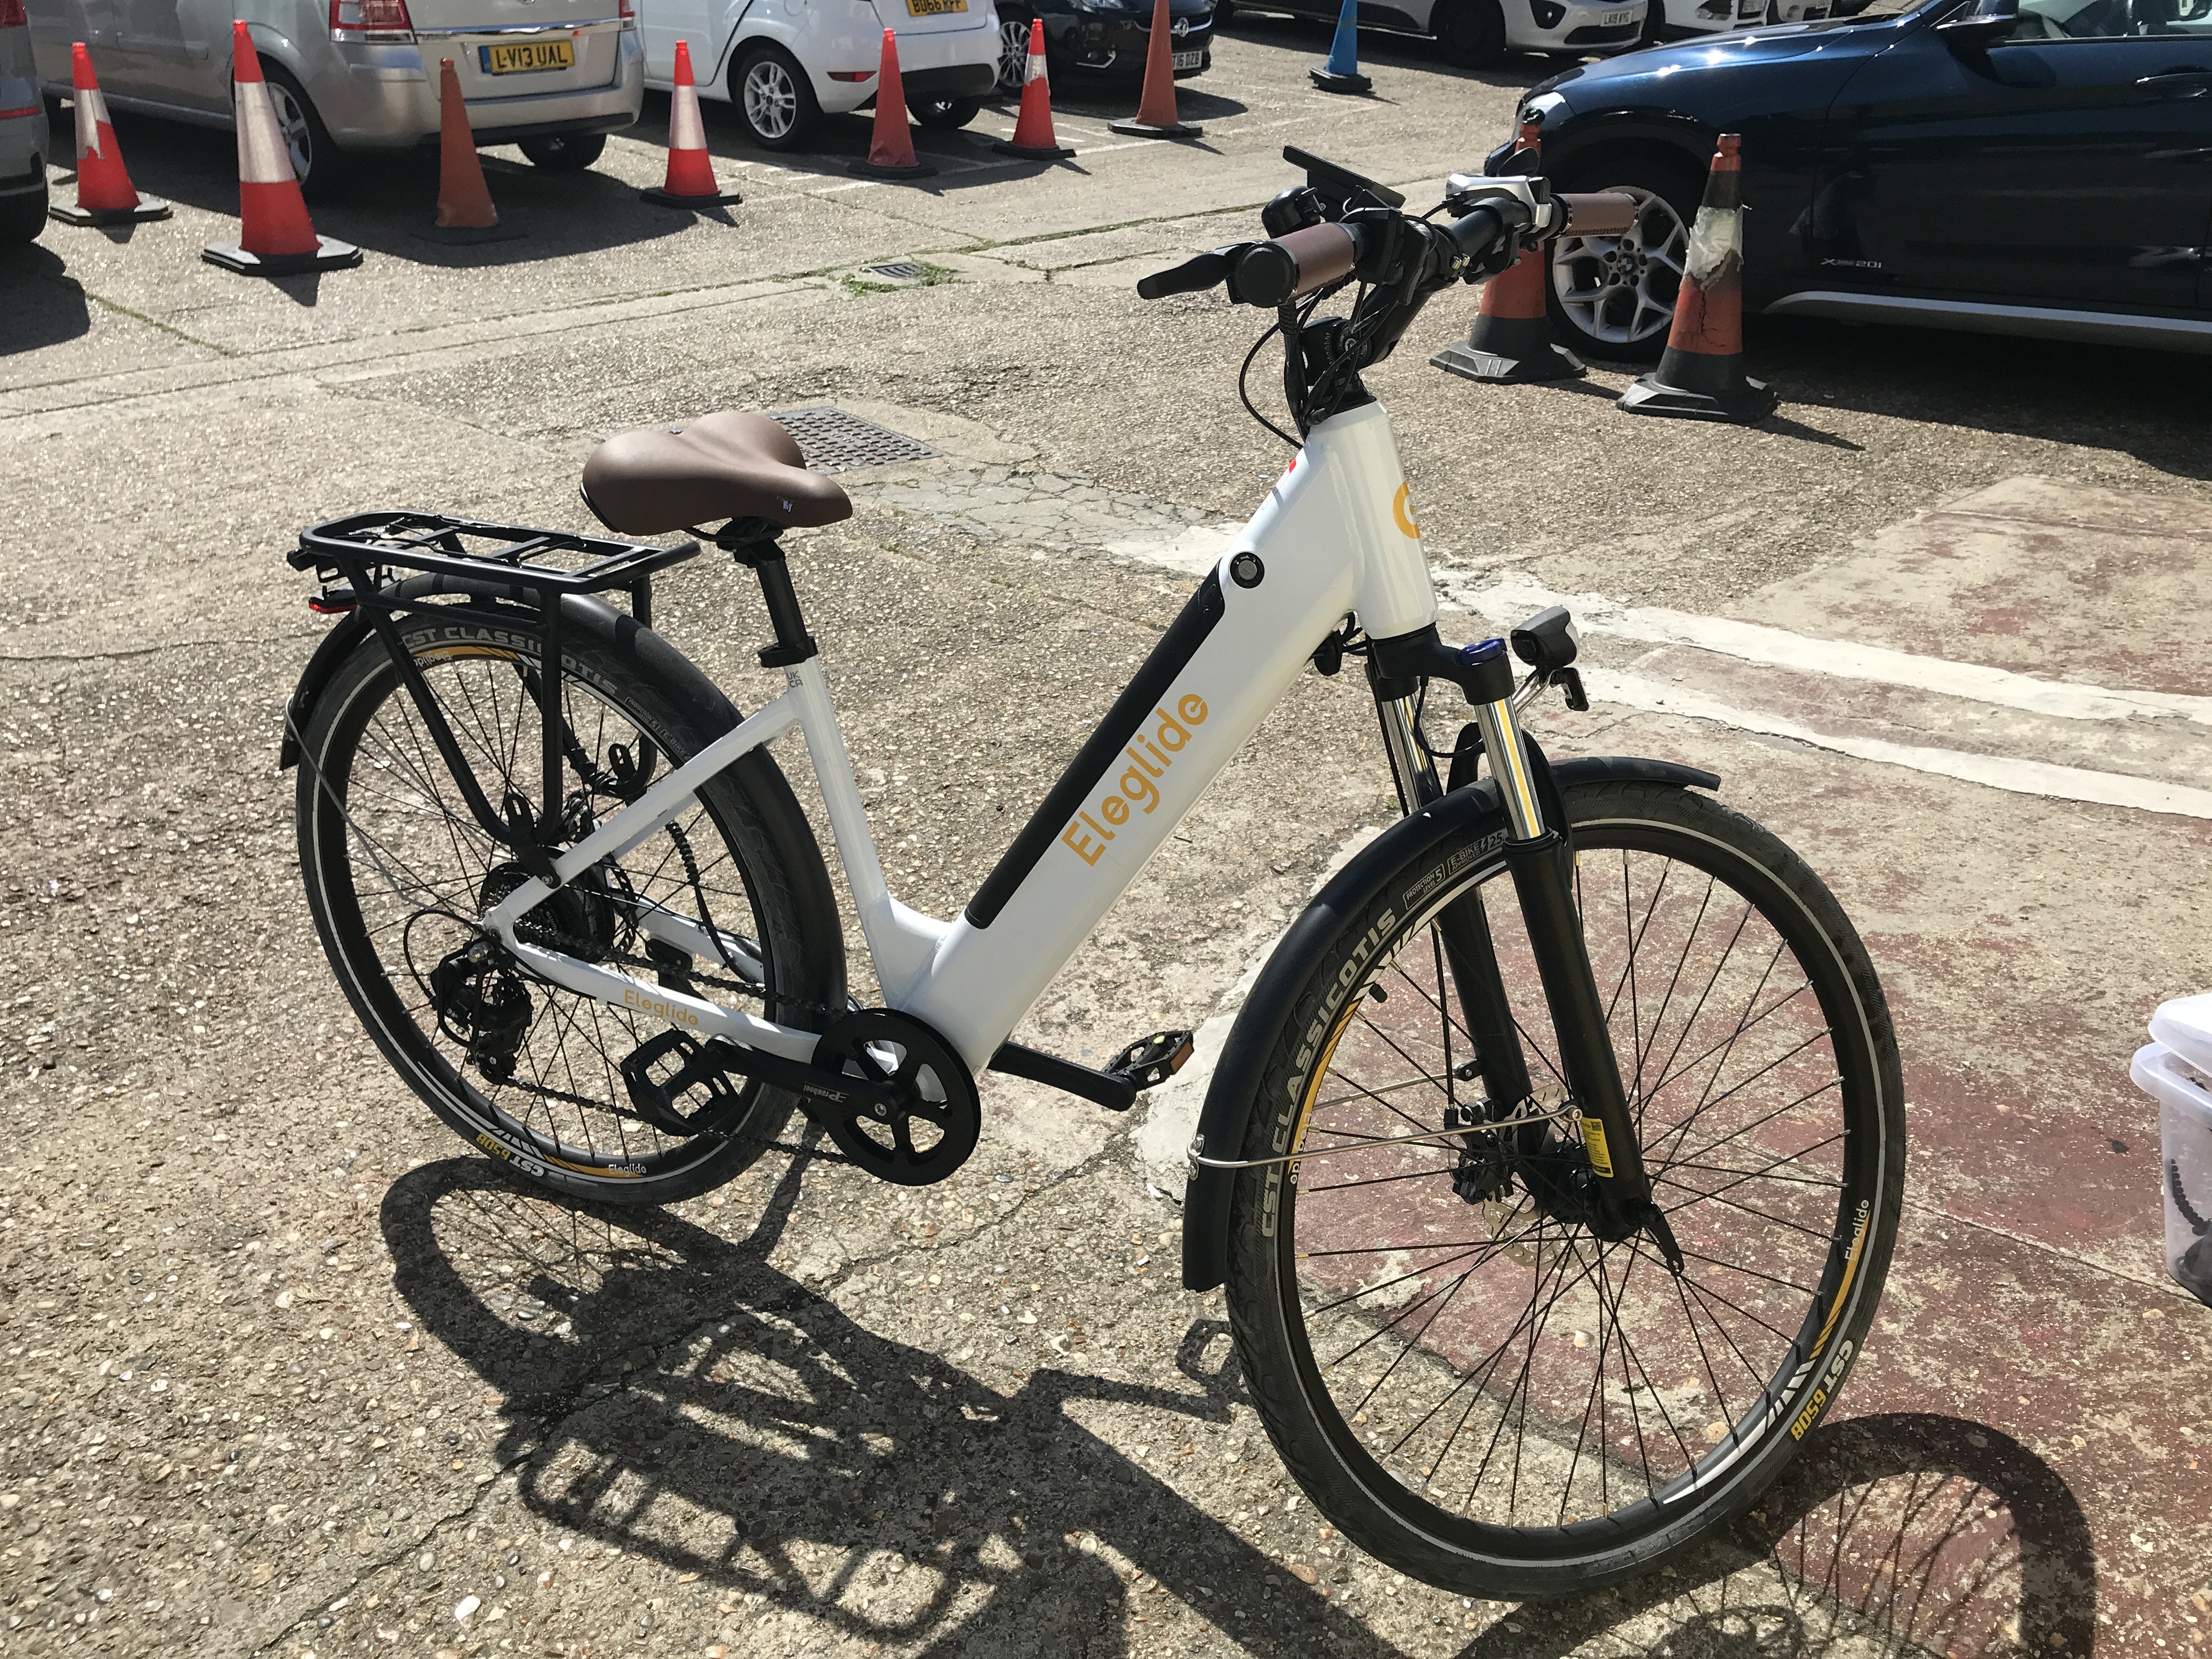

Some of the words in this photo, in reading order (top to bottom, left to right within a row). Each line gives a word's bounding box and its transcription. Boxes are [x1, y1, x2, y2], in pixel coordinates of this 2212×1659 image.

[495, 47, 533, 68] LV13
[537, 45, 567, 65] UAL
[786, 670, 800, 680] UK
[789, 679, 803, 688] CA
[1062, 693, 1208, 867] Eleglide
[1451, 843, 1480, 866] E-BIKE
[1489, 832, 1503, 848] 25
[1452, 851, 1480, 871] APPROVED
[1406, 873, 1435, 900] PROTECTION
[1435, 868, 1442, 882] 5
[1423, 882, 1436, 893] LEVEL
[624, 989, 699, 1025] Eleglide
[476, 1133, 510, 1160] 650B
[509, 1155, 544, 1177] CST
[1262, 1165, 1279, 1237] CST
[1845, 1199, 1869, 1261] Eleglide
[1824, 1340, 1853, 1394] CST
[1791, 1389, 1826, 1441] 650B
